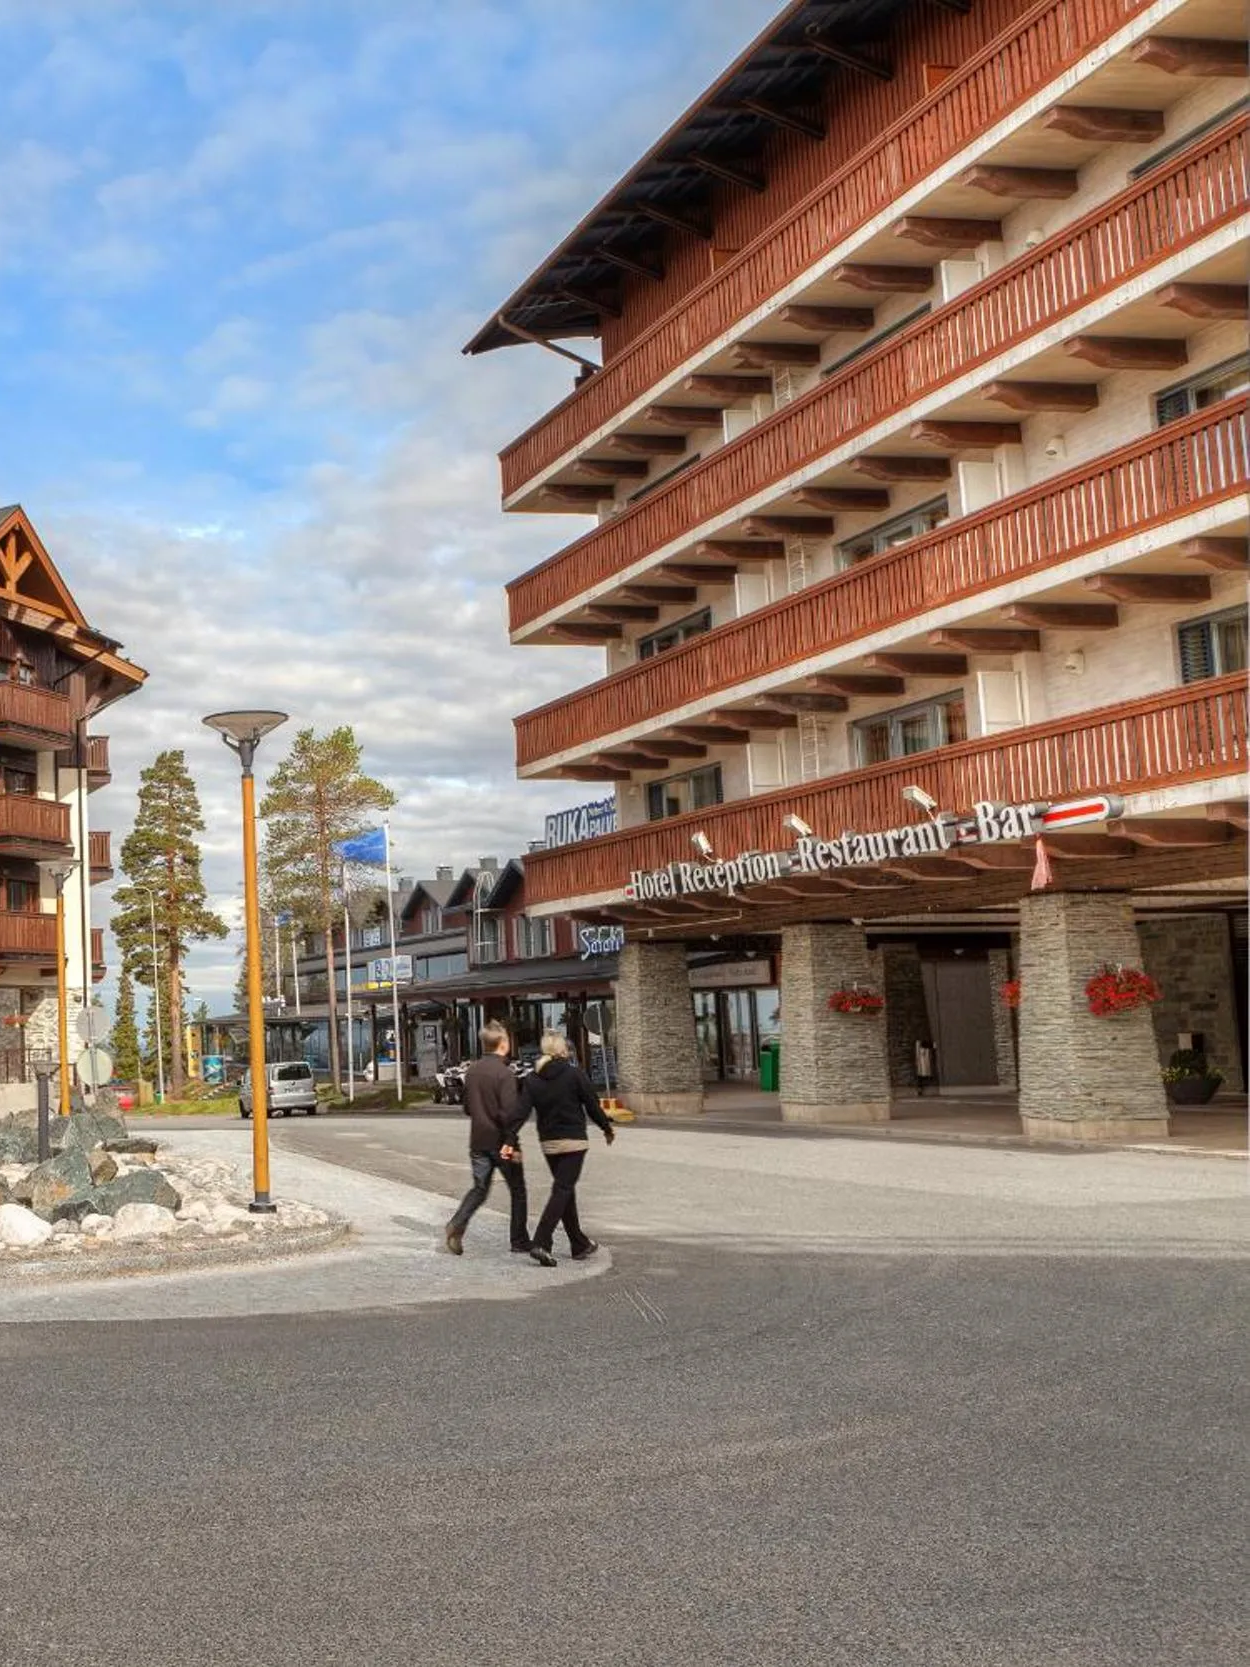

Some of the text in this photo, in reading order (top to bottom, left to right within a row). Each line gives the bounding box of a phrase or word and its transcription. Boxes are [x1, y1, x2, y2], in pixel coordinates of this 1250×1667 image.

[545, 805, 590, 849] RUKA
[630, 800, 1036, 900] Hotel Reception Restaurant Bar
